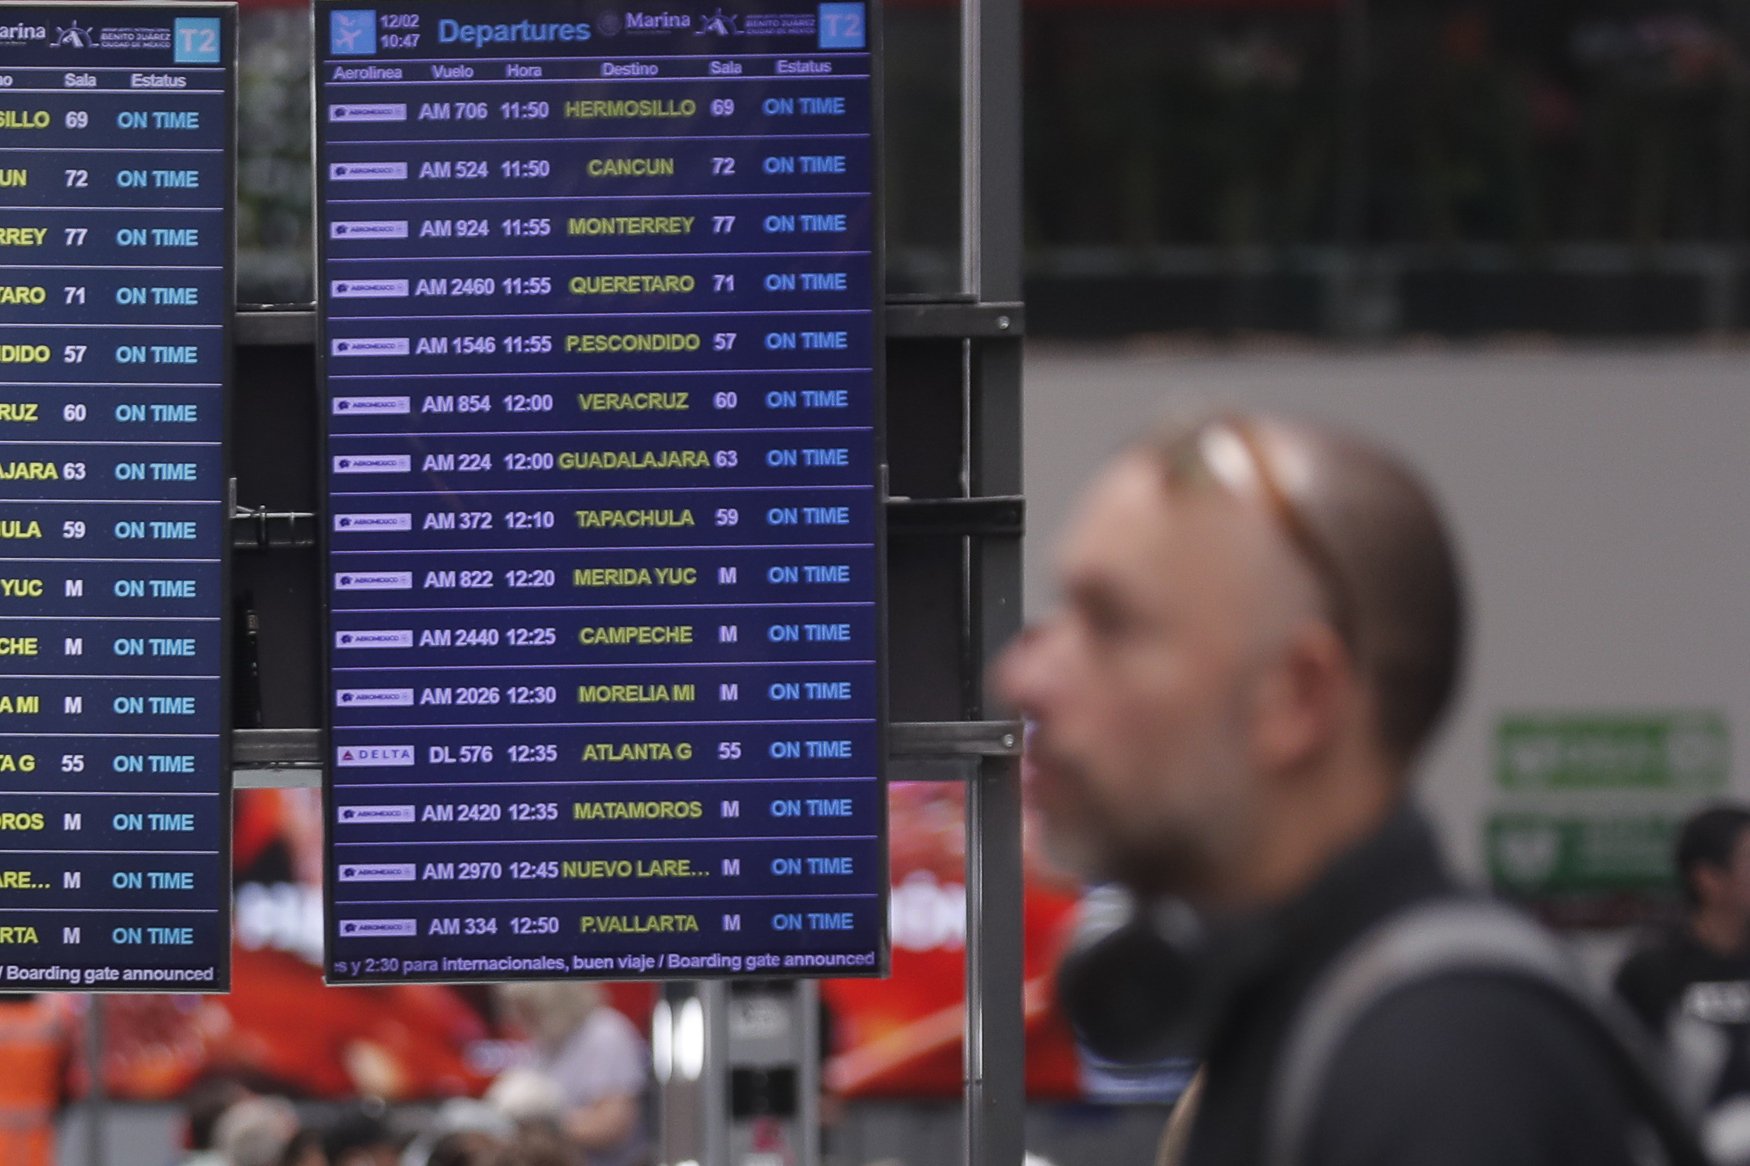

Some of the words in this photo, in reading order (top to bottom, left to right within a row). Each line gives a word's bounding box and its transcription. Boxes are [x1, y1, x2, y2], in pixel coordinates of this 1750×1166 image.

[625, 12, 691, 29] Marina
[822, 13, 862, 37] T2
[178, 28, 217, 52] T2
[438, 18, 592, 48] Departures
[64, 72, 97, 87] Sala
[130, 73, 187, 88] Estatus
[64, 169, 88, 187] 72
[116, 169, 147, 187] ON
[151, 170, 199, 188] TIME
[418, 219, 452, 237] AM
[453, 218, 490, 237] 924
[500, 218, 551, 237] 11:55
[568, 216, 694, 234] MONTERREY
[712, 215, 736, 233] 77
[763, 214, 795, 232] ON
[798, 213, 847, 232] TIME
[63, 344, 87, 363] 57
[115, 345, 146, 363] ON
[149, 345, 198, 363] TIME
[420, 395, 454, 413] AM
[456, 394, 492, 413] 854
[502, 393, 553, 412] 12:00
[578, 392, 689, 410] VERACRUZ
[712, 391, 738, 409] 60
[765, 390, 797, 408] ON
[800, 389, 849, 408] TIME
[62, 520, 86, 538] 59
[114, 521, 145, 538] ON
[148, 521, 196, 539] TIME
[422, 570, 456, 588] AM
[458, 569, 494, 588] 822
[504, 569, 555, 587] 12:20
[574, 568, 652, 585] MERIDA
[654, 567, 696, 584] YUC
[717, 566, 737, 584] M
[767, 565, 798, 583] ON
[802, 565, 850, 583] TIME
[15, 695, 39, 713] MI
[63, 695, 82, 714] M
[112, 696, 143, 714] ON
[147, 696, 195, 714] TIME
[358, 749, 410, 760] DELTA
[428, 745, 457, 764] DL
[458, 744, 493, 763] 576
[506, 744, 558, 762] 12:35
[582, 743, 673, 760] ATLANTA
[675, 742, 692, 760] G
[717, 741, 742, 760] 55
[768, 741, 800, 758] ON
[804, 740, 852, 758] TIME
[62, 871, 81, 889] M
[111, 871, 142, 889] ON
[146, 871, 194, 889] TIME
[427, 917, 460, 935] AM
[463, 917, 498, 935] 334
[509, 916, 560, 934] 12:50
[721, 913, 741, 931] M
[771, 913, 802, 930] ON
[806, 912, 854, 930] TIME
[6, 965, 81, 984] Boarding
[84, 966, 120, 984] gate
[122, 966, 214, 981] announced
